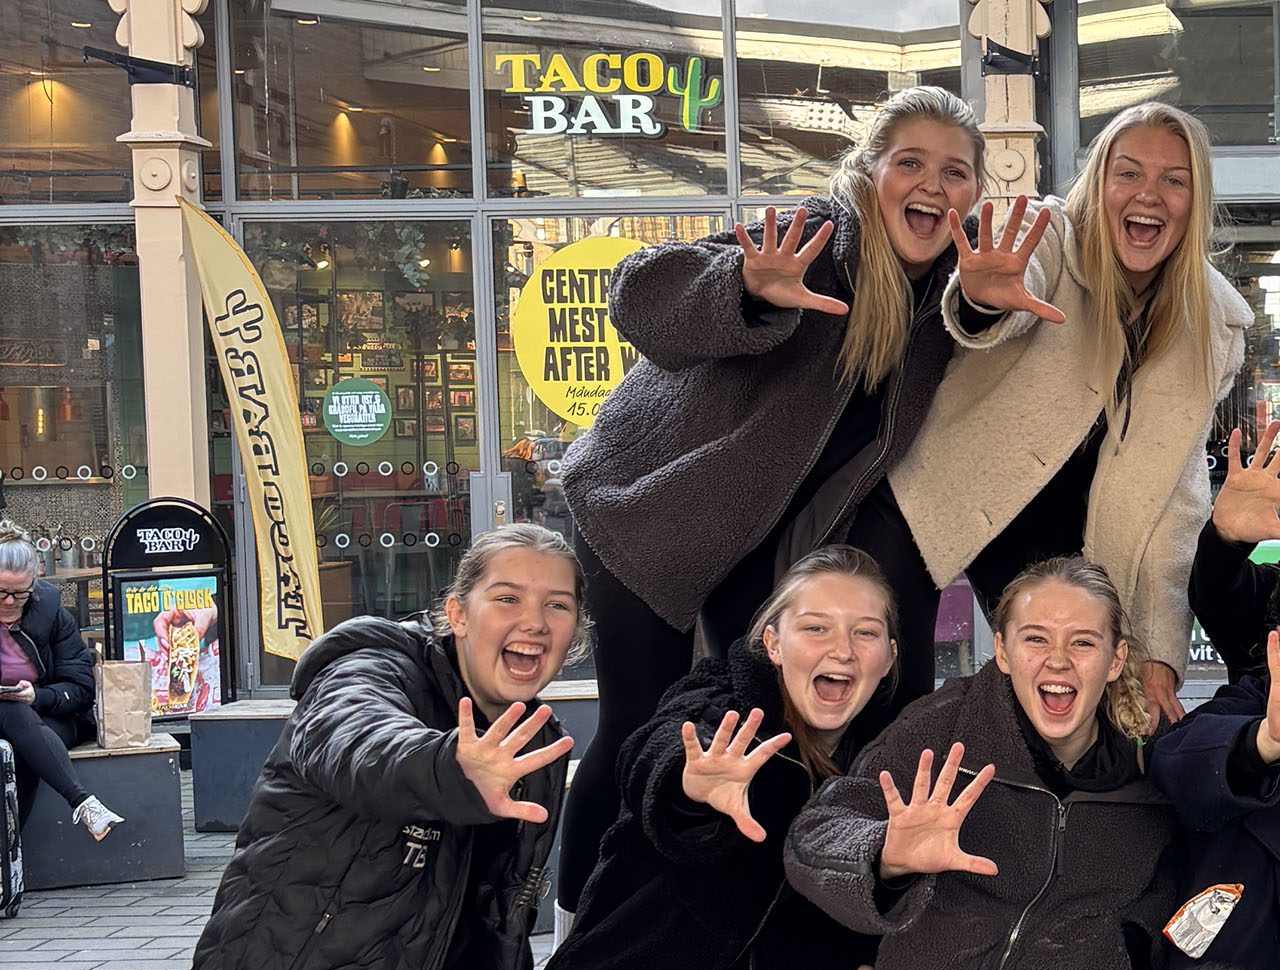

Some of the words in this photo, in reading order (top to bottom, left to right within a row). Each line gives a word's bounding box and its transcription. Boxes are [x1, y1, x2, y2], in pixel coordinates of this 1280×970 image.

[494, 53, 664, 93] TACO
[524, 94, 661, 135] BAR
[541, 269, 612, 304] CENTR
[548, 307, 608, 343] MEST
[543, 346, 610, 382] AFTER
[566, 402, 600, 416] 15.0
[137, 528, 184, 542] TACO
[145, 540, 184, 553] BAR
[125, 591, 160, 614] TACO
